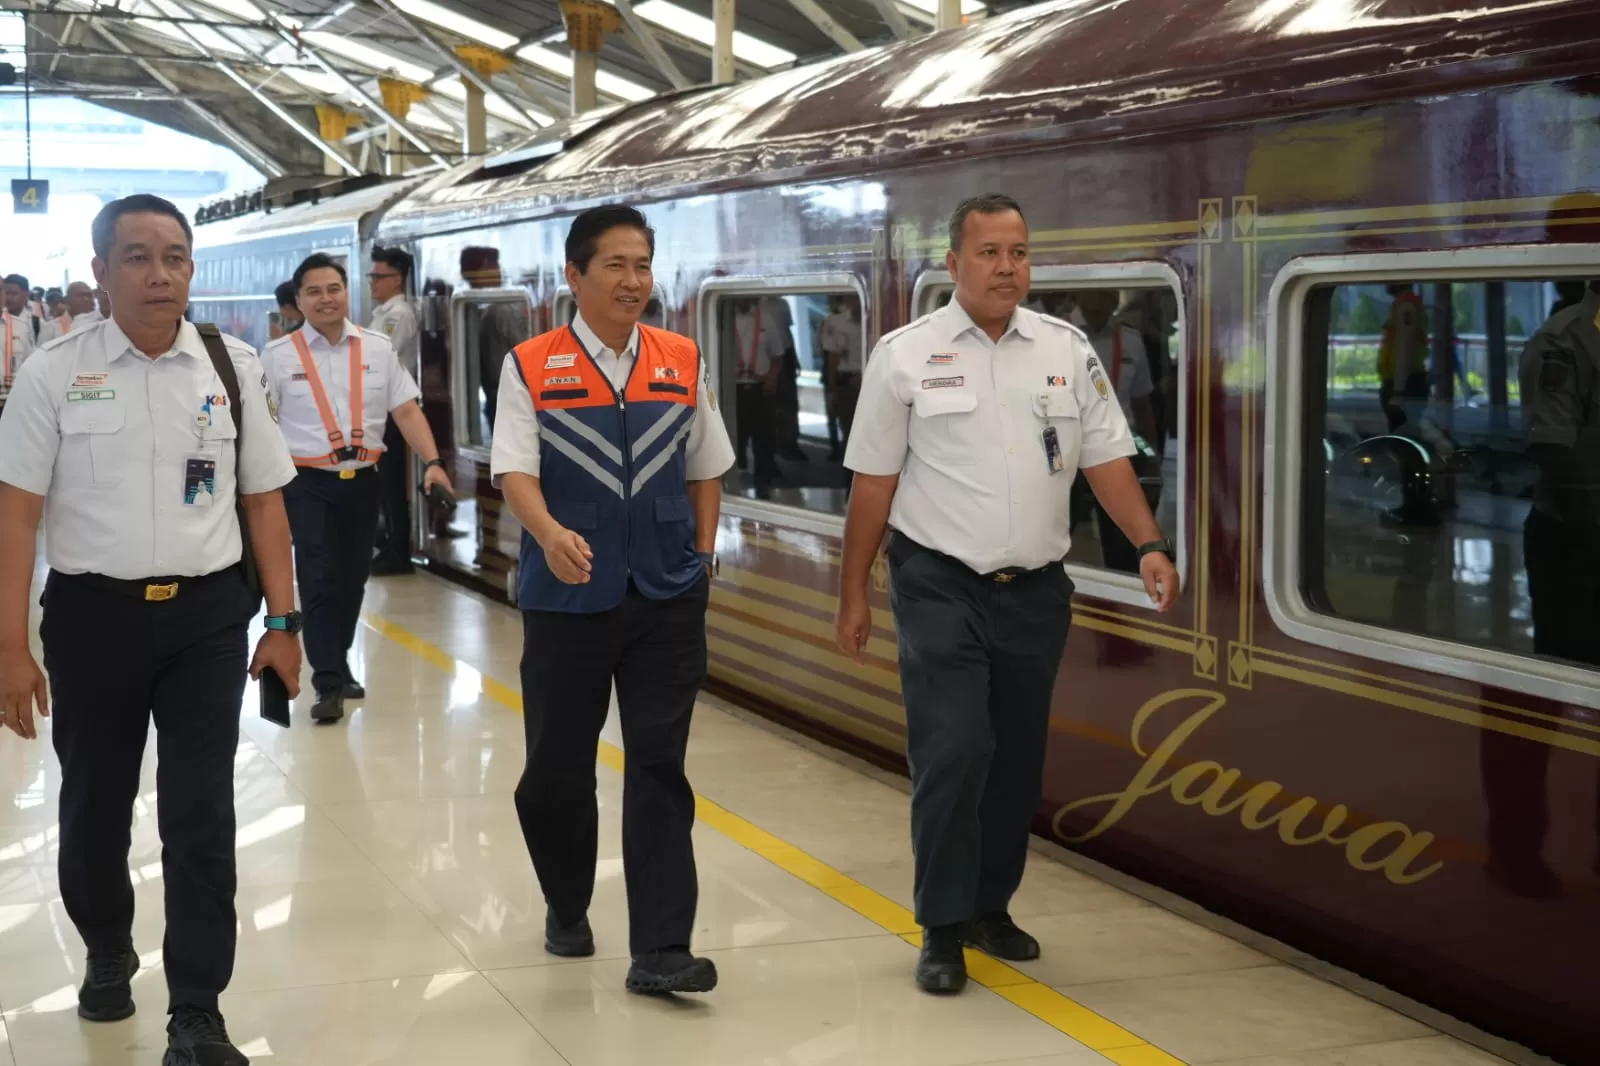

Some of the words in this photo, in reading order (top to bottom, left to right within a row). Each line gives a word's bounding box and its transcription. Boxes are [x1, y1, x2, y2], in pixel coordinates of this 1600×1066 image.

[22, 187, 40, 208] 4
[80, 392, 101, 400] SIGIT
[1052, 688, 1444, 884] Jawa
